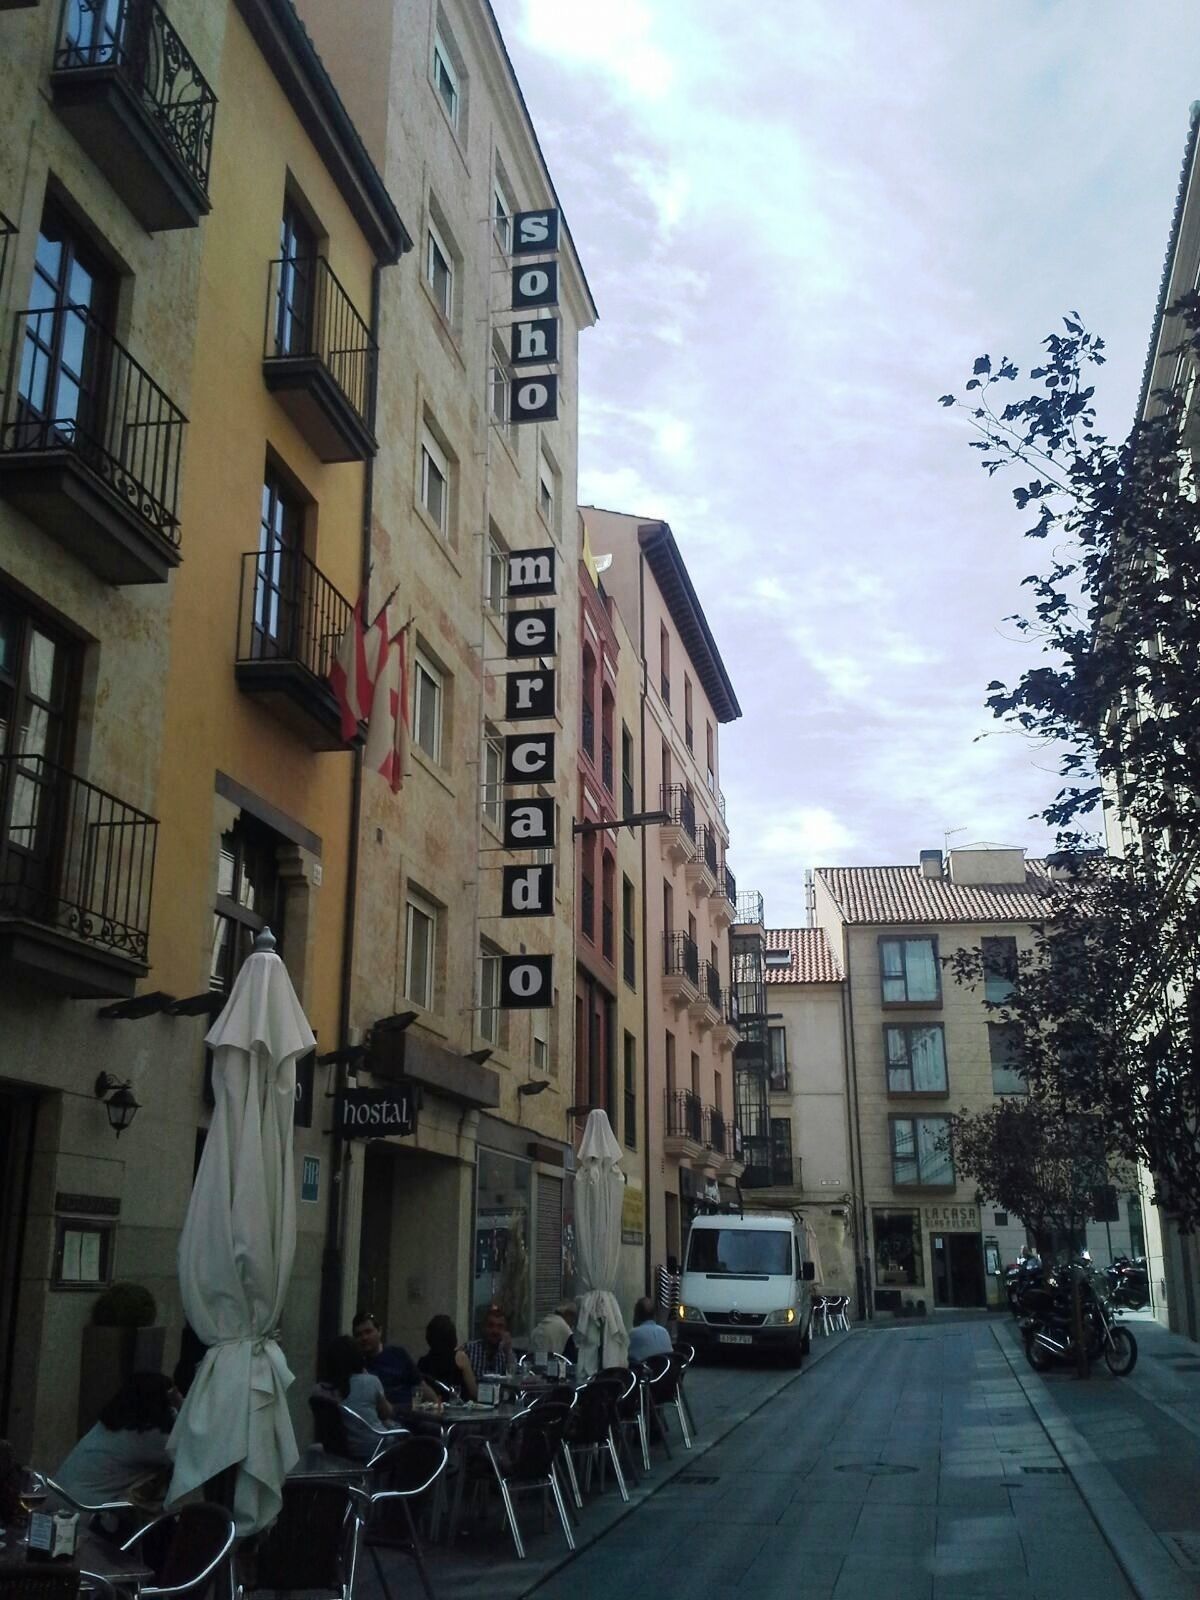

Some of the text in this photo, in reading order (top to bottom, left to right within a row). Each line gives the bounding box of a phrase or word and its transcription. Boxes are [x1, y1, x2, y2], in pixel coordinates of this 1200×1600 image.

[518, 216, 549, 410] soho
[509, 554, 552, 997] mercado
[343, 1097, 410, 1125] hostal
[924, 1207, 976, 1219] LA CASA
